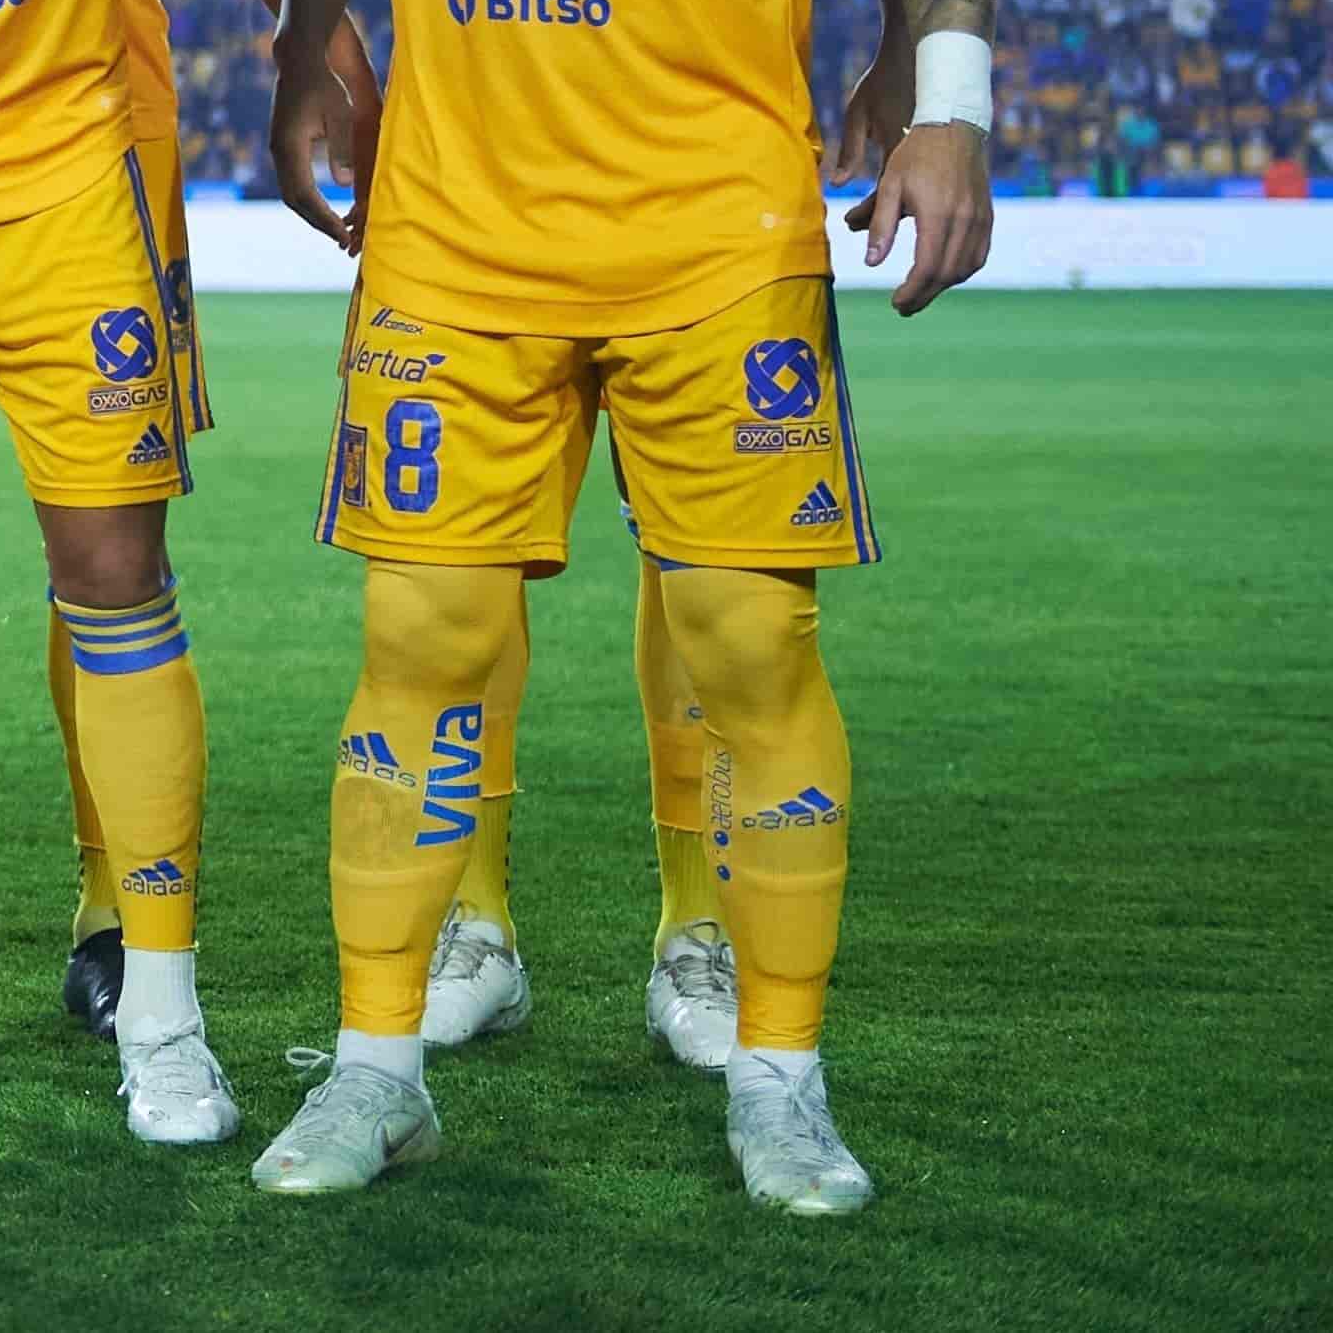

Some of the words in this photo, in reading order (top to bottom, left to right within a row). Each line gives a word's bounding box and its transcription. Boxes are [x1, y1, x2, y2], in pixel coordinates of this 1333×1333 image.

[384, 399, 442, 513] 8
[737, 432, 783, 448] OXXO
[785, 427, 832, 447] GAS
[414, 702, 483, 848] viva
[707, 746, 733, 831] aerobus
[121, 875, 193, 897] adidas
